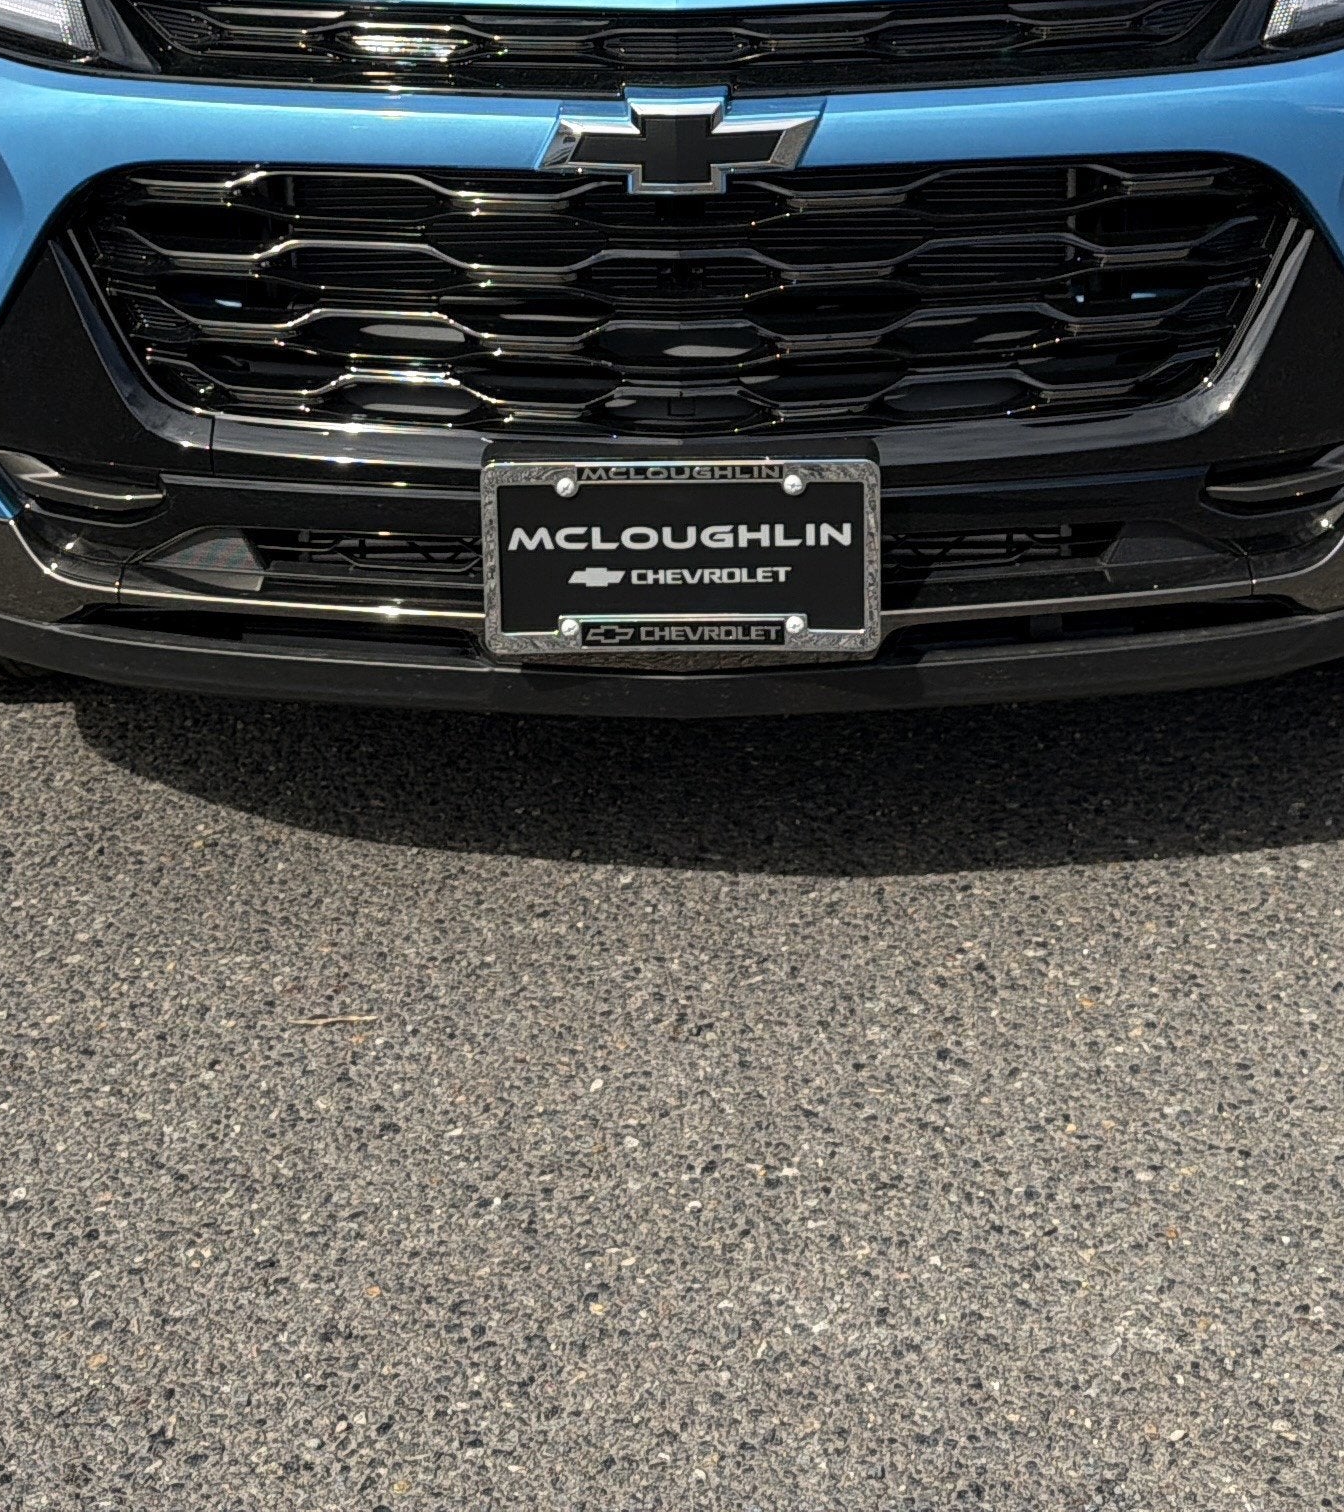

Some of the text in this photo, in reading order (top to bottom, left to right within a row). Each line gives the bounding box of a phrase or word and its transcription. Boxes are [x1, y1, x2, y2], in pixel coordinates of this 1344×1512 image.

[581, 465, 780, 481] MCLOUGHLIN
[507, 522, 853, 551] MCLOUGHLIN
[631, 566, 792, 585] CHEVROLET
[639, 625, 781, 641] CHEVROLET
